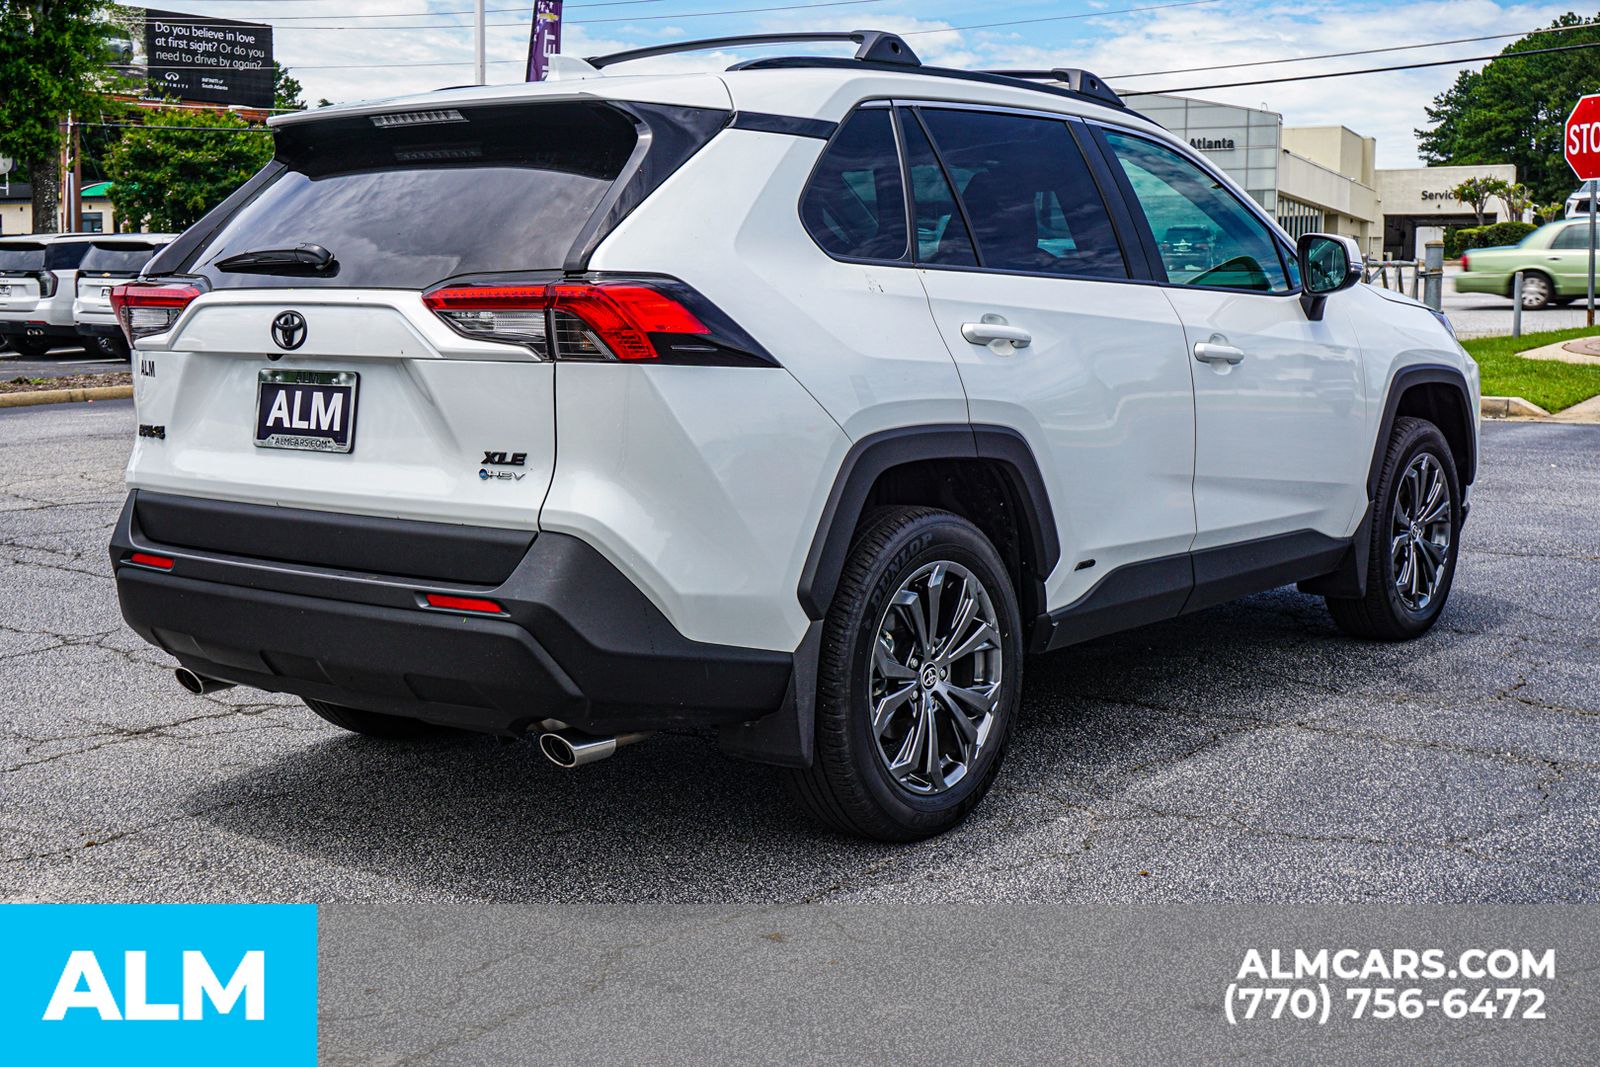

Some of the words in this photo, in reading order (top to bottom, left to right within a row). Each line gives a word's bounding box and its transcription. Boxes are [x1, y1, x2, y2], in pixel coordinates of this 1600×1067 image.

[155, 22, 170, 33] Do
[172, 26, 190, 36] you
[192, 27, 224, 40] believe
[226, 30, 235, 41] in
[236, 32, 256, 44] love
[155, 37, 166, 46] at
[168, 37, 188, 49] first
[189, 40, 217, 53] sight?
[219, 43, 231, 54] Or
[234, 45, 246, 56] do
[248, 49, 265, 58] you
[155, 51, 180, 62] need
[182, 53, 193, 63] to
[194, 54, 217, 66] drive
[219, 58, 231, 69] by
[232, 60, 263, 71] again?
[1190, 137, 1235, 149] Atlanta
[1568, 121, 1600, 155] STO
[140, 359, 156, 377] ALM
[265, 389, 344, 431] ALM
[480, 451, 528, 466] XLE
